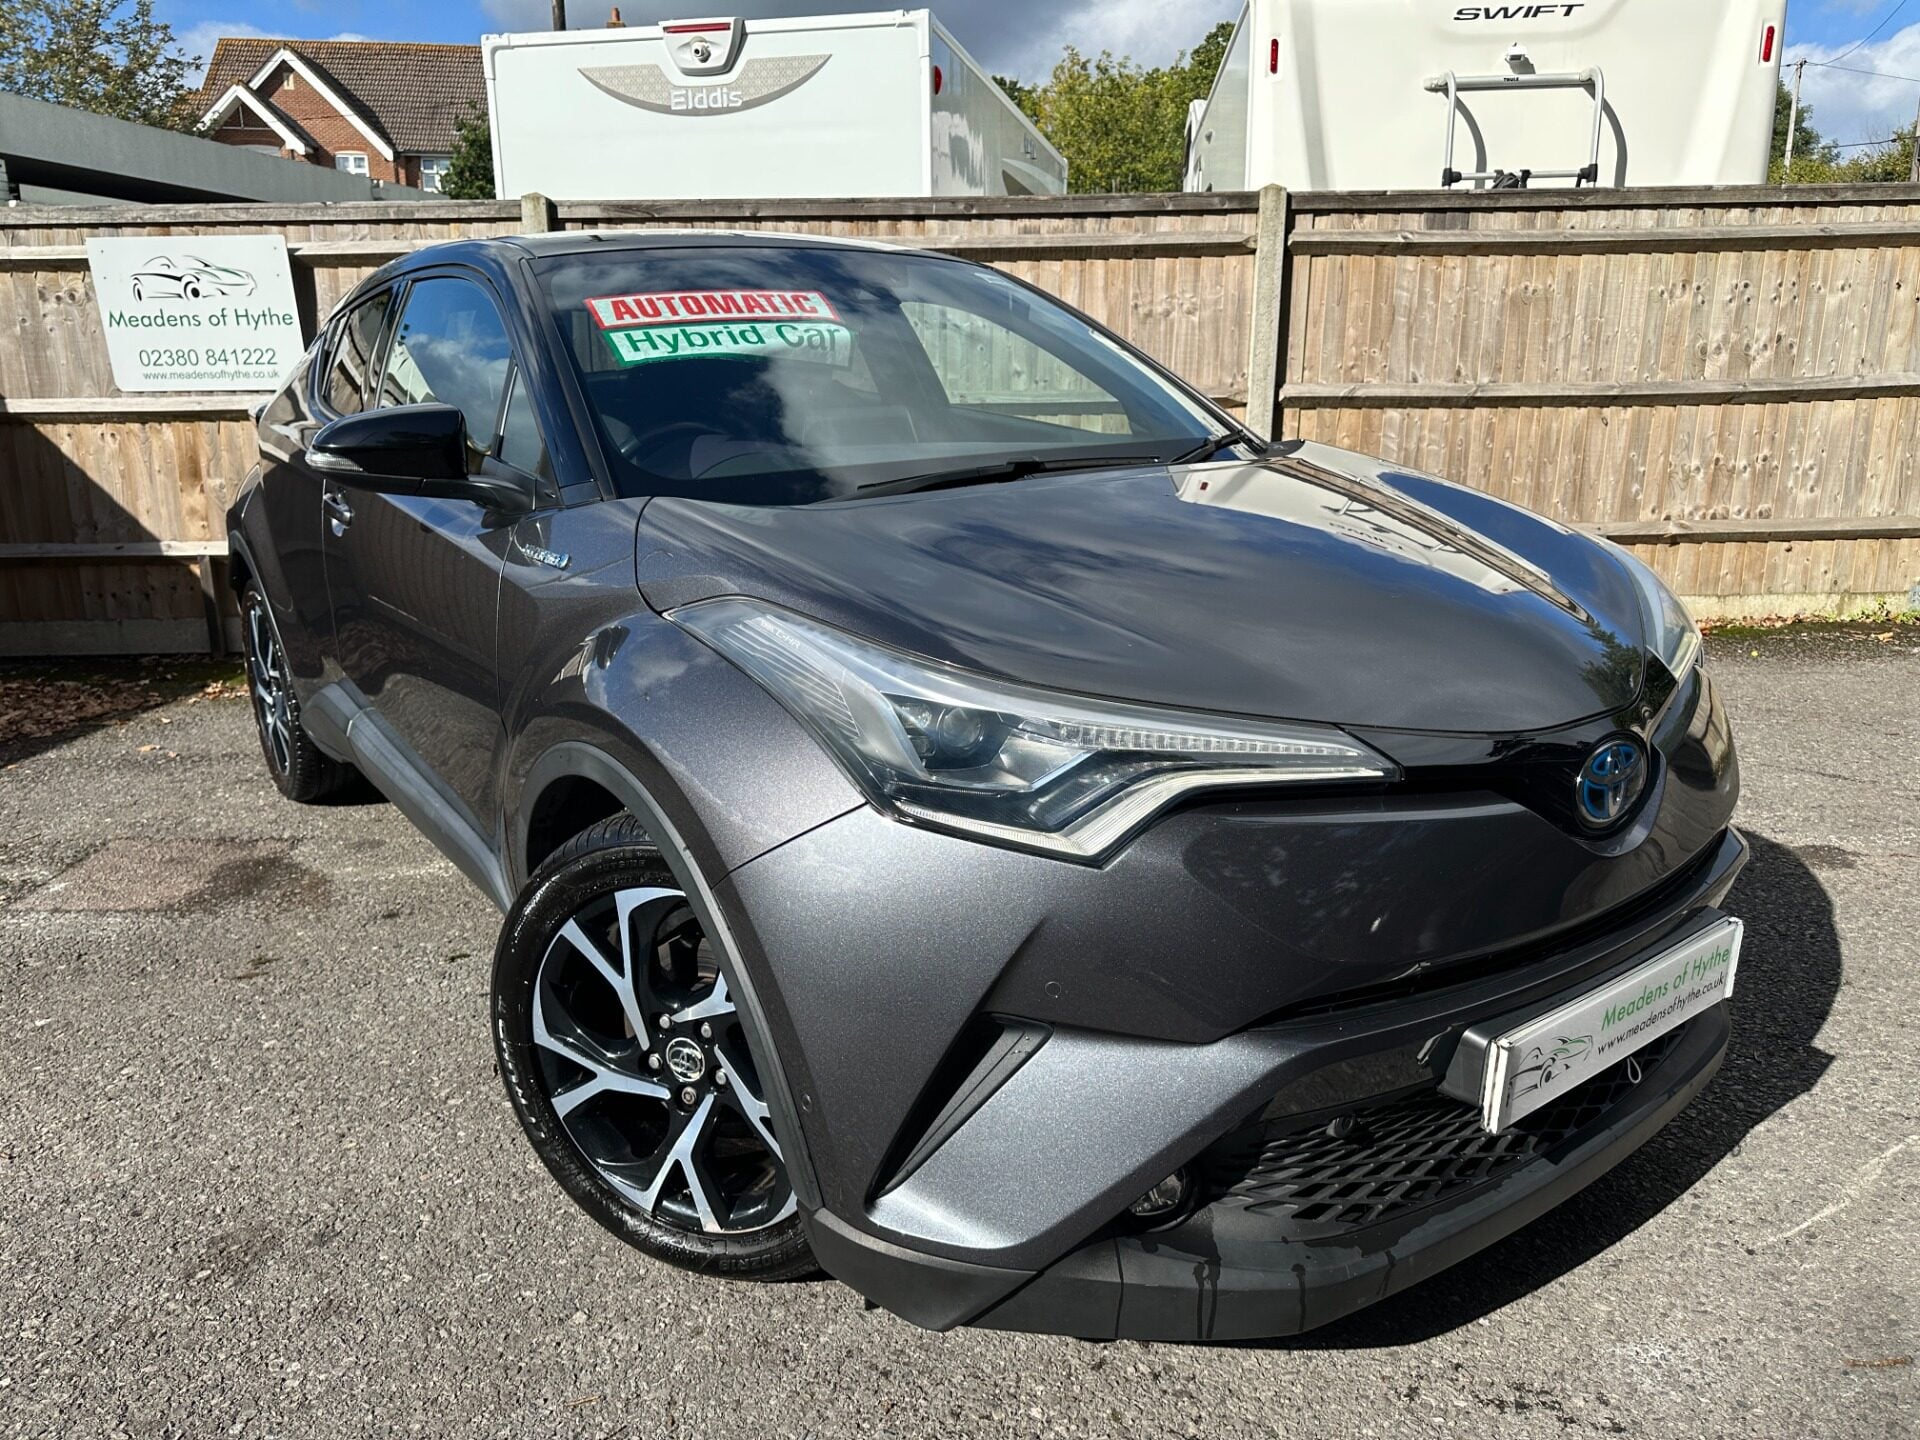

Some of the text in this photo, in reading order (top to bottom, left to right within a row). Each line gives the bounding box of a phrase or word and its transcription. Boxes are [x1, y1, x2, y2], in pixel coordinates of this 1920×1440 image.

[1453, 3, 1585, 21] SWIFT
[669, 87, 744, 111] Elddis
[610, 291, 819, 321] AUTOMATIC
[108, 307, 294, 331] Meadens of Hythe
[623, 324, 840, 354] Hybrid Car
[139, 348, 278, 367] 02380 841222
[142, 370, 279, 381] www.meadensofhythe.co.uk
[1601, 946, 1730, 1031] Meadens of Hythe
[1597, 971, 1725, 1056] www.meadensofhythe.co.uk
